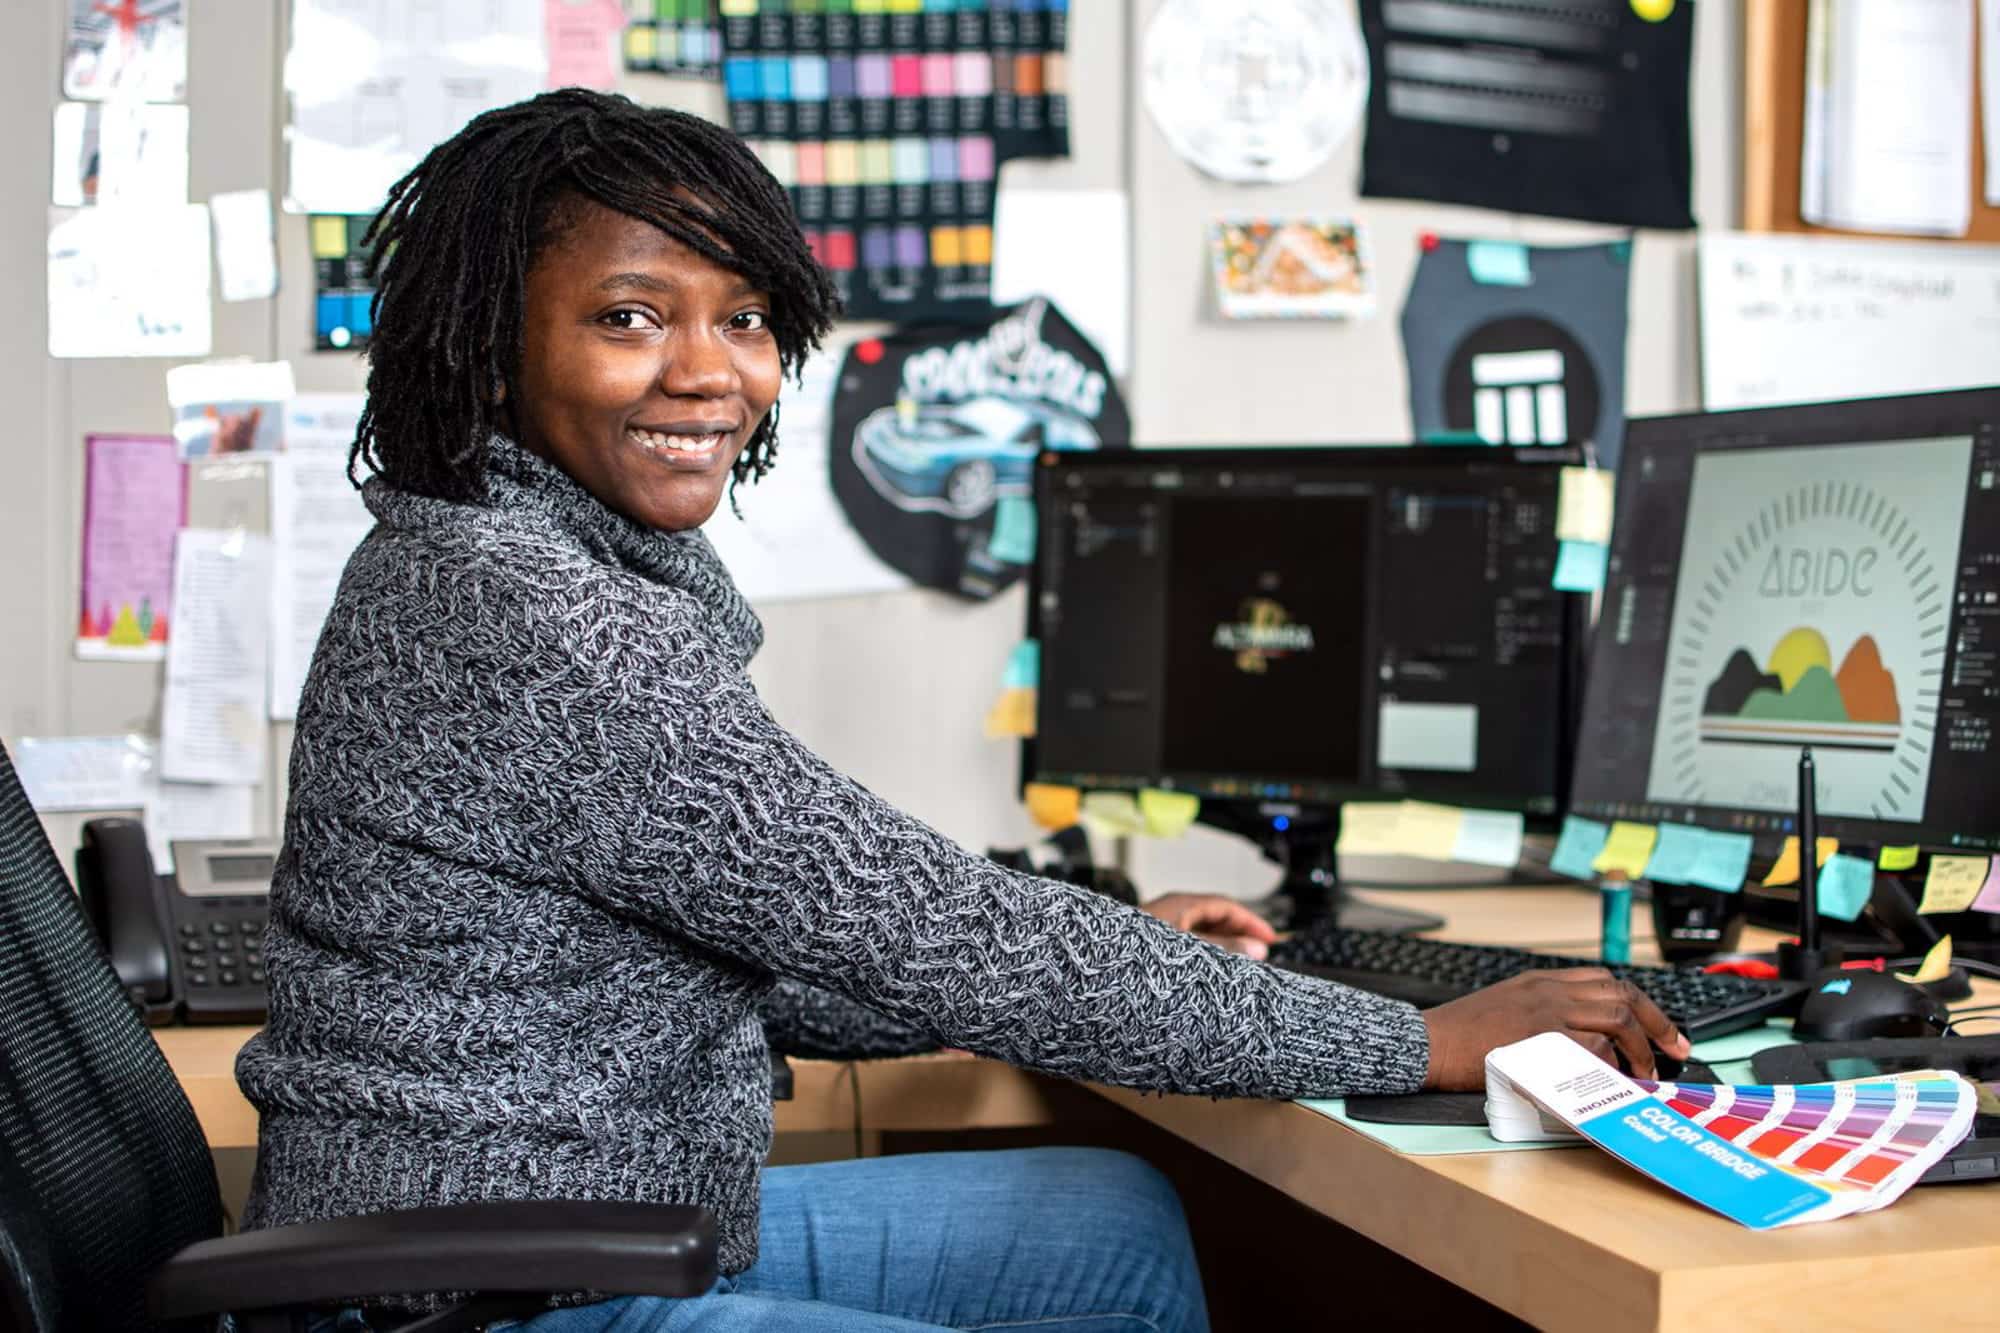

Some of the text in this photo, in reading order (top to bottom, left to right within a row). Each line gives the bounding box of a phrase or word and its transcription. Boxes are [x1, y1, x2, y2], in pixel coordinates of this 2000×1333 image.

[1575, 1089, 1634, 1115] PANTONE
[1622, 1114, 1668, 1143] Coated
[1640, 1106, 1769, 1180] COLOR BRIDGE
